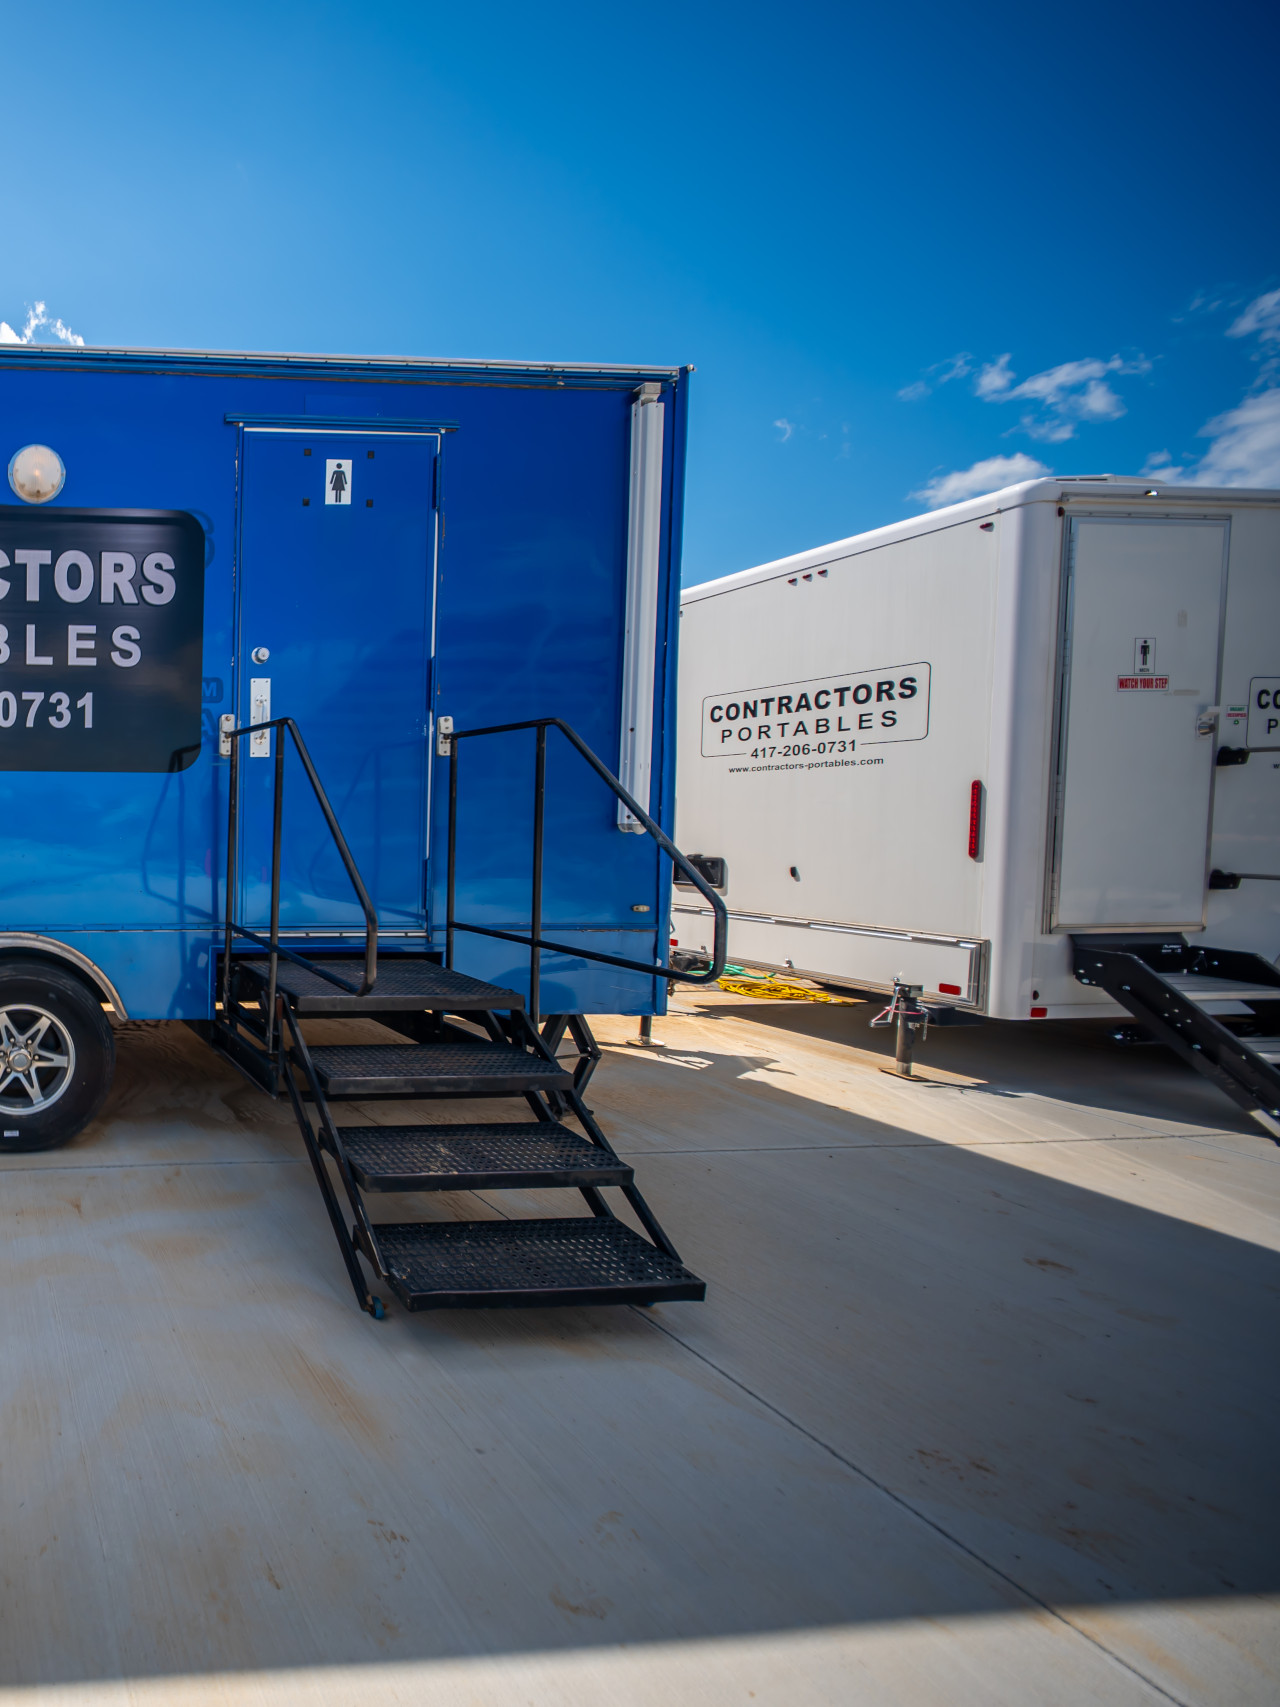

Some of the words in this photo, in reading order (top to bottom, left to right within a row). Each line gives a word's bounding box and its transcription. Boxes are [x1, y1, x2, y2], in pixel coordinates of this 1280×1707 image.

[1119, 678, 1138, 689] WATCH
[1140, 678, 1154, 689] YOUR
[1155, 678, 1168, 689] STEP
[710, 677, 918, 723] CONTRACTORS
[721, 710, 898, 744] PORTABLES
[750, 740, 857, 759] 417-206-0731
[728, 757, 885, 773] www.contractors-portables.com
